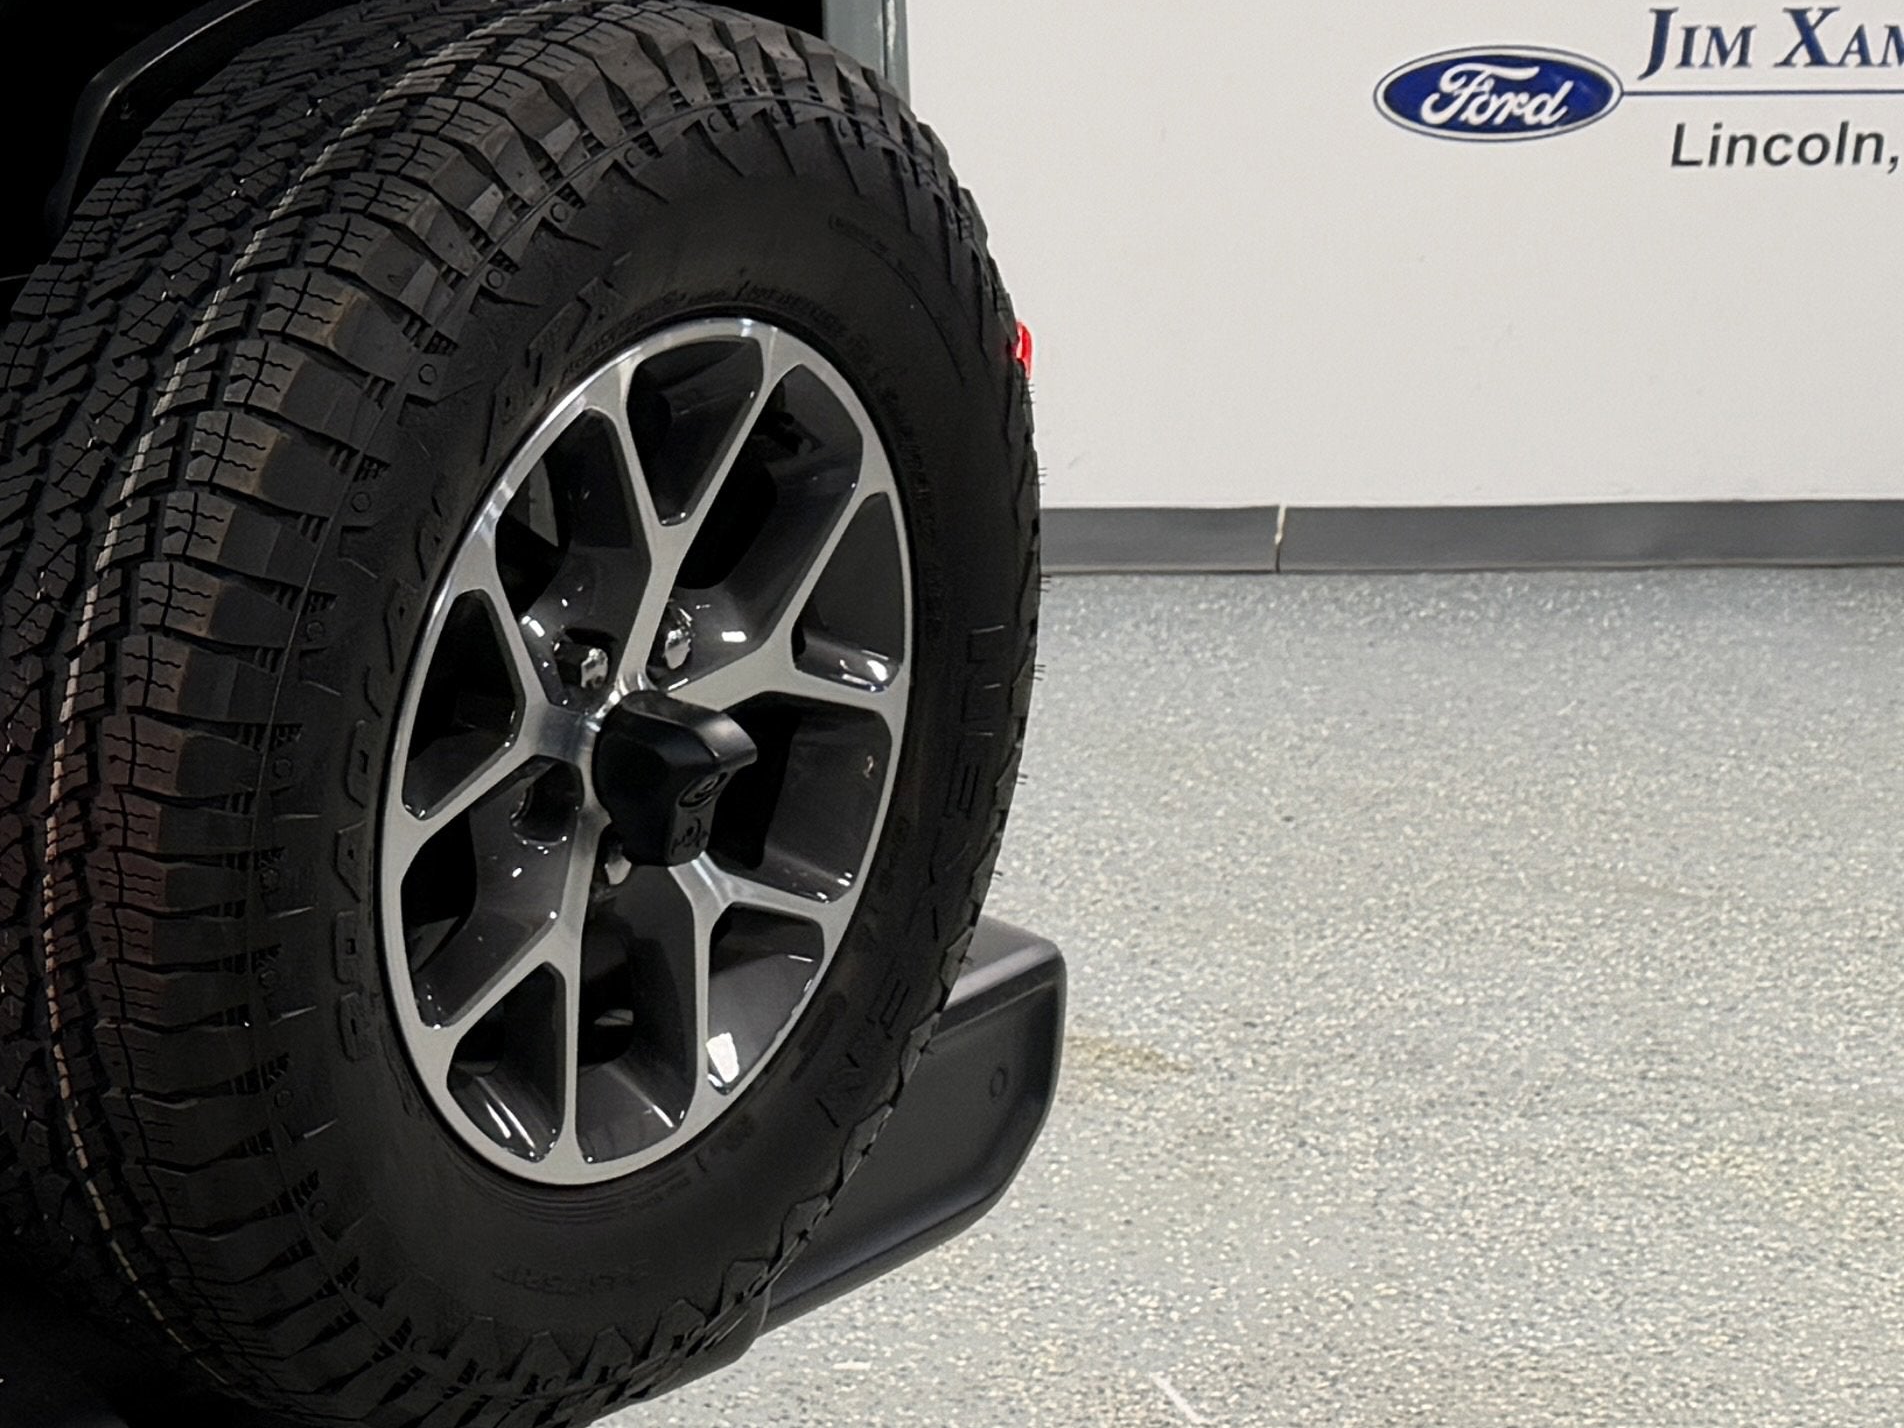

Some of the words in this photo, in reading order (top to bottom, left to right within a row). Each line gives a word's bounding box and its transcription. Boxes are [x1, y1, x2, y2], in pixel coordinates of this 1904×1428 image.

[1637, 7, 1756, 81] JIM
[1420, 62, 1570, 126] Ford
[1671, 120, 1900, 174] Lincoln,
